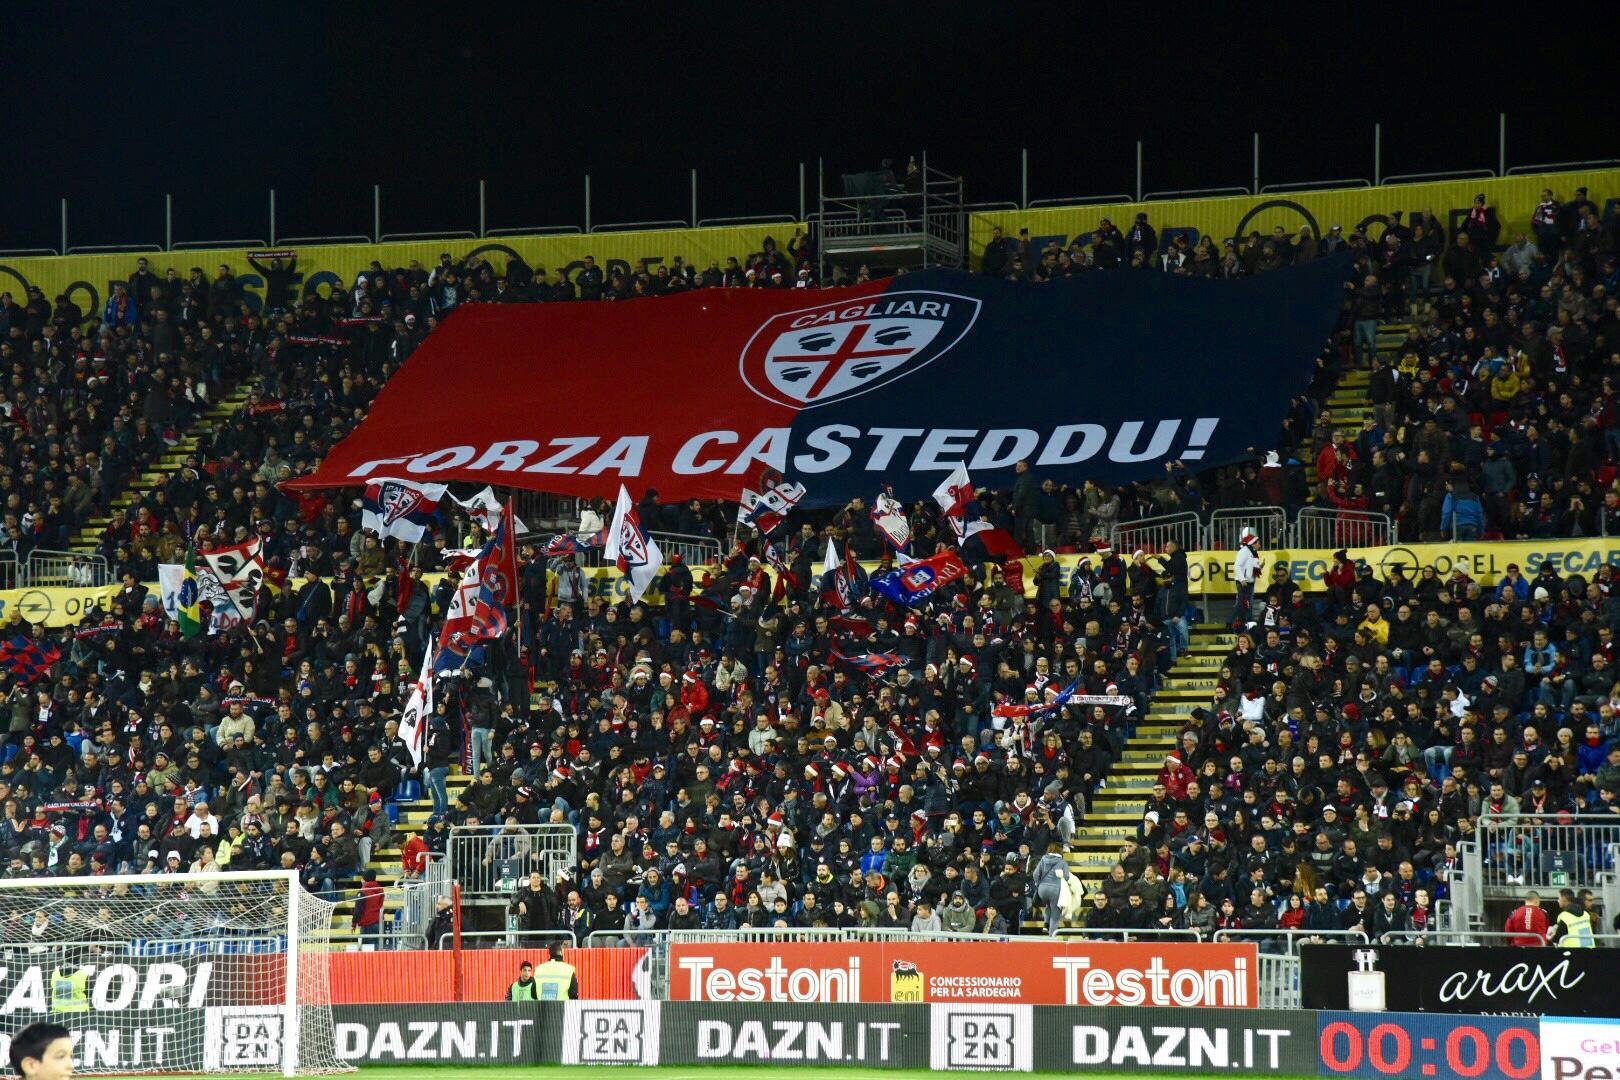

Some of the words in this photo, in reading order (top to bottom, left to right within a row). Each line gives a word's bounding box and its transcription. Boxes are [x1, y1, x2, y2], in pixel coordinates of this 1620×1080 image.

[790, 300, 951, 329] CAGLIARI
[346, 436, 650, 477] FORZA
[671, 417, 1220, 475] CASTEDDU!
[1188, 561, 1236, 583] OPE
[679, 956, 860, 1002] Testoni
[929, 976, 1022, 988] CONCESSIONARIO
[930, 987, 949, 998] PER
[951, 987, 964, 998] LA
[966, 987, 1022, 998] SARDEGNA
[1053, 956, 1248, 1007] Testoni
[1438, 950, 1585, 1004] araxi
[334, 1020, 534, 1060] DAZN.IT
[596, 1018, 630, 1034] DA
[697, 1020, 901, 1061] DAZN.IT
[964, 1022, 999, 1038] DA
[595, 1037, 628, 1054] ZN
[964, 1042, 998, 1059] ZN
[1072, 1024, 1292, 1069] DAZN.IT
[1320, 1021, 1540, 1079] 00:00
